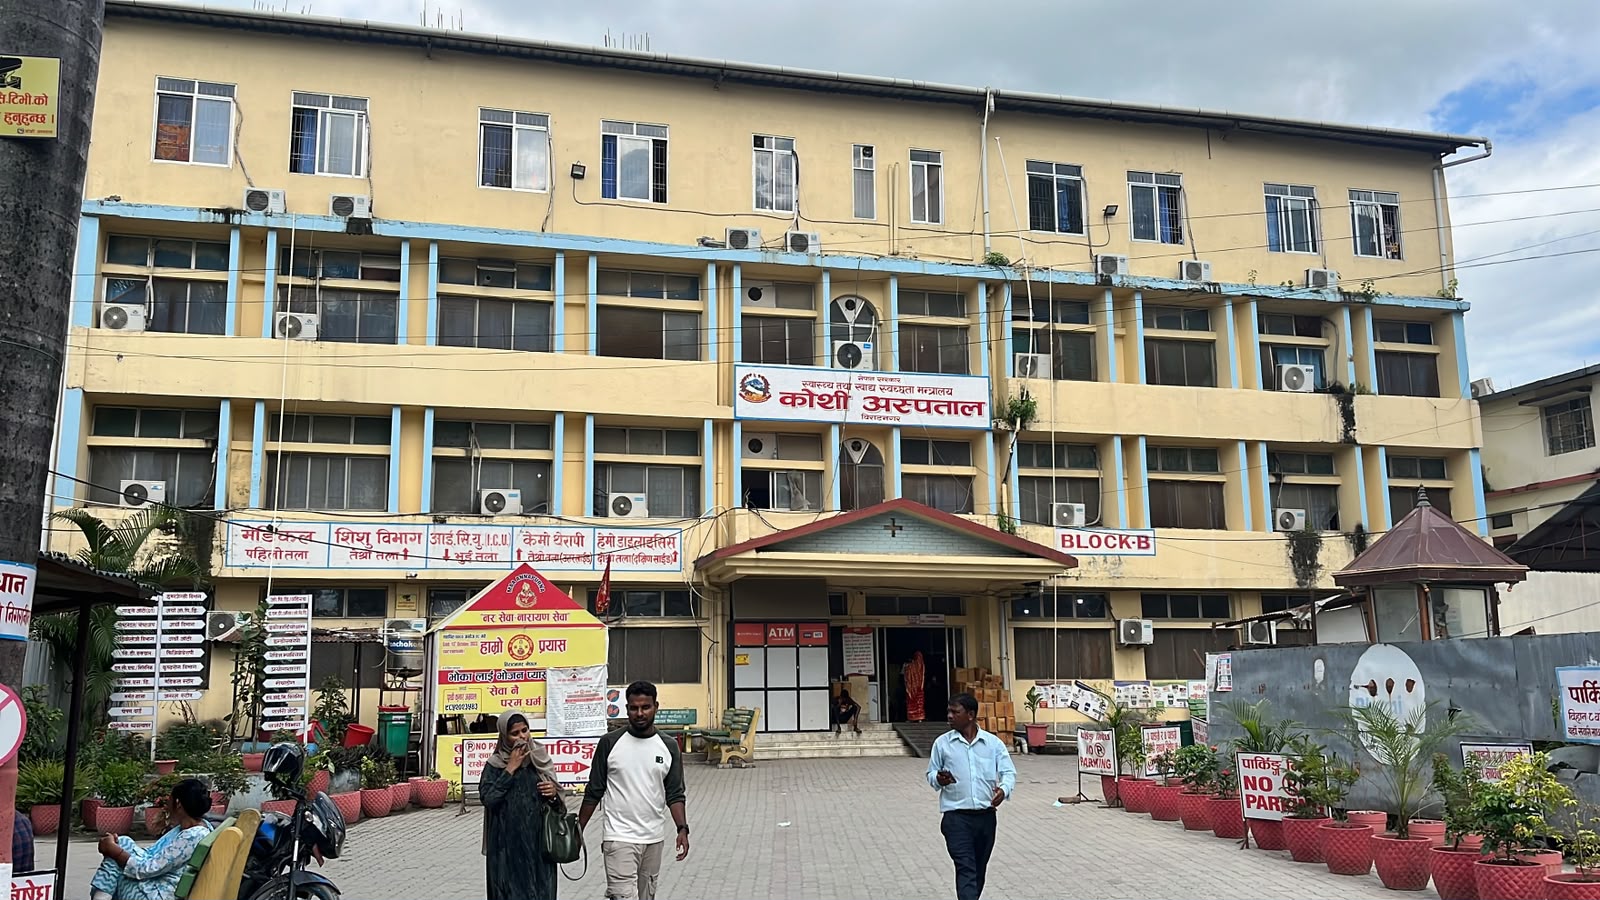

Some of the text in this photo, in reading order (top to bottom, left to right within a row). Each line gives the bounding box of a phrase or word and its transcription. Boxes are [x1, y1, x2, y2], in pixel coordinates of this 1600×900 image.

[836, 382, 851, 391] तथा
[917, 387, 953, 396] मन्त्रालय
[779, 389, 985, 416] कोशी अस्पताल
[861, 413, 900, 422] विराटनगर
[335, 527, 422, 549] शिशु विभाग
[523, 531, 585, 548] केमो थेरापी
[597, 532, 616, 549] हेमो
[1061, 534, 1151, 550] BLOCK-B
[245, 547, 309, 562] पहिलो तला
[376, 551, 399, 561] तला
[475, 552, 499, 562] तला
[769, 627, 794, 638] ATM
[480, 637, 567, 655] हाम्रो प्रयास
[448, 670, 472, 682] भोका
[475, 670, 494, 682] लाई
[496, 669, 524, 681] भोजन
[500, 699, 522, 707] परम
[525, 696, 542, 706] धर्म
[1243, 775, 1273, 792] NO
